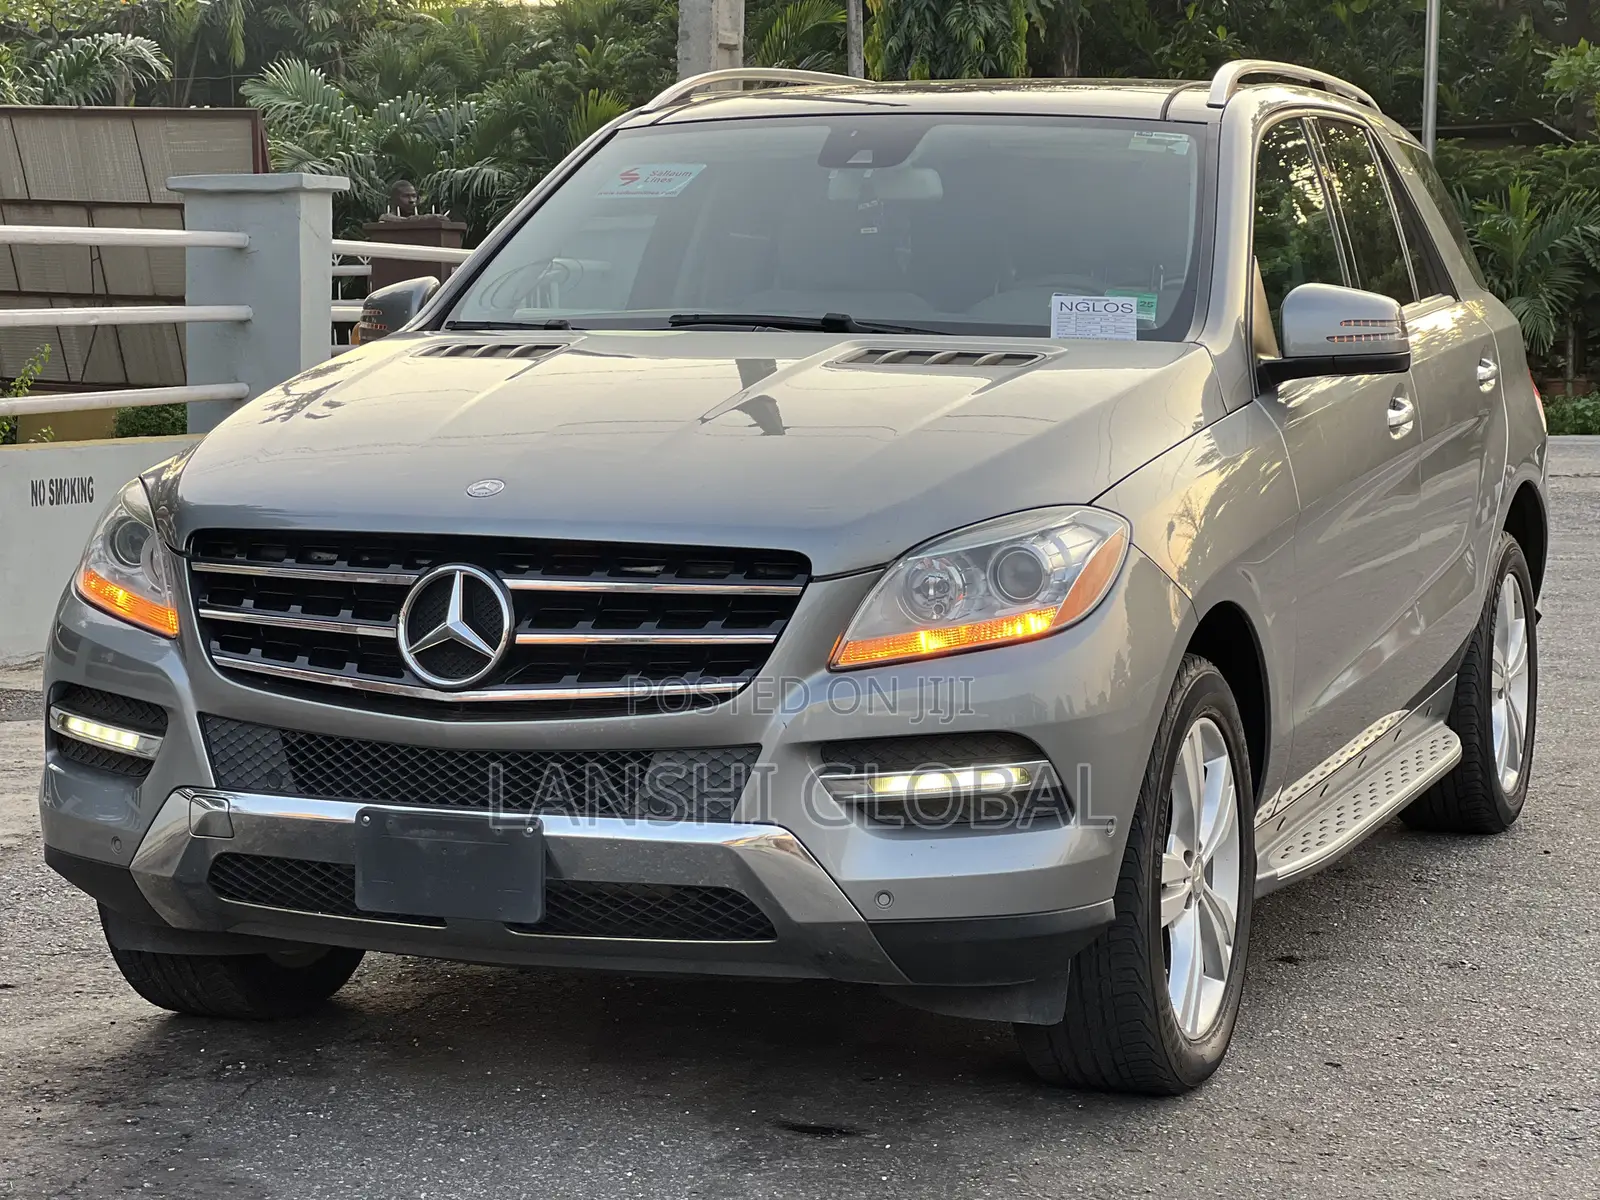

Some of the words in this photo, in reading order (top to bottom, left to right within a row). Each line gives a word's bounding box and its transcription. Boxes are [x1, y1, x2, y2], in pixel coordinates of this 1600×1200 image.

[1060, 301, 1134, 314] NGLOS
[1139, 300, 1154, 308] 25
[31, 479, 46, 507] NO
[48, 476, 94, 506] SMOKING
